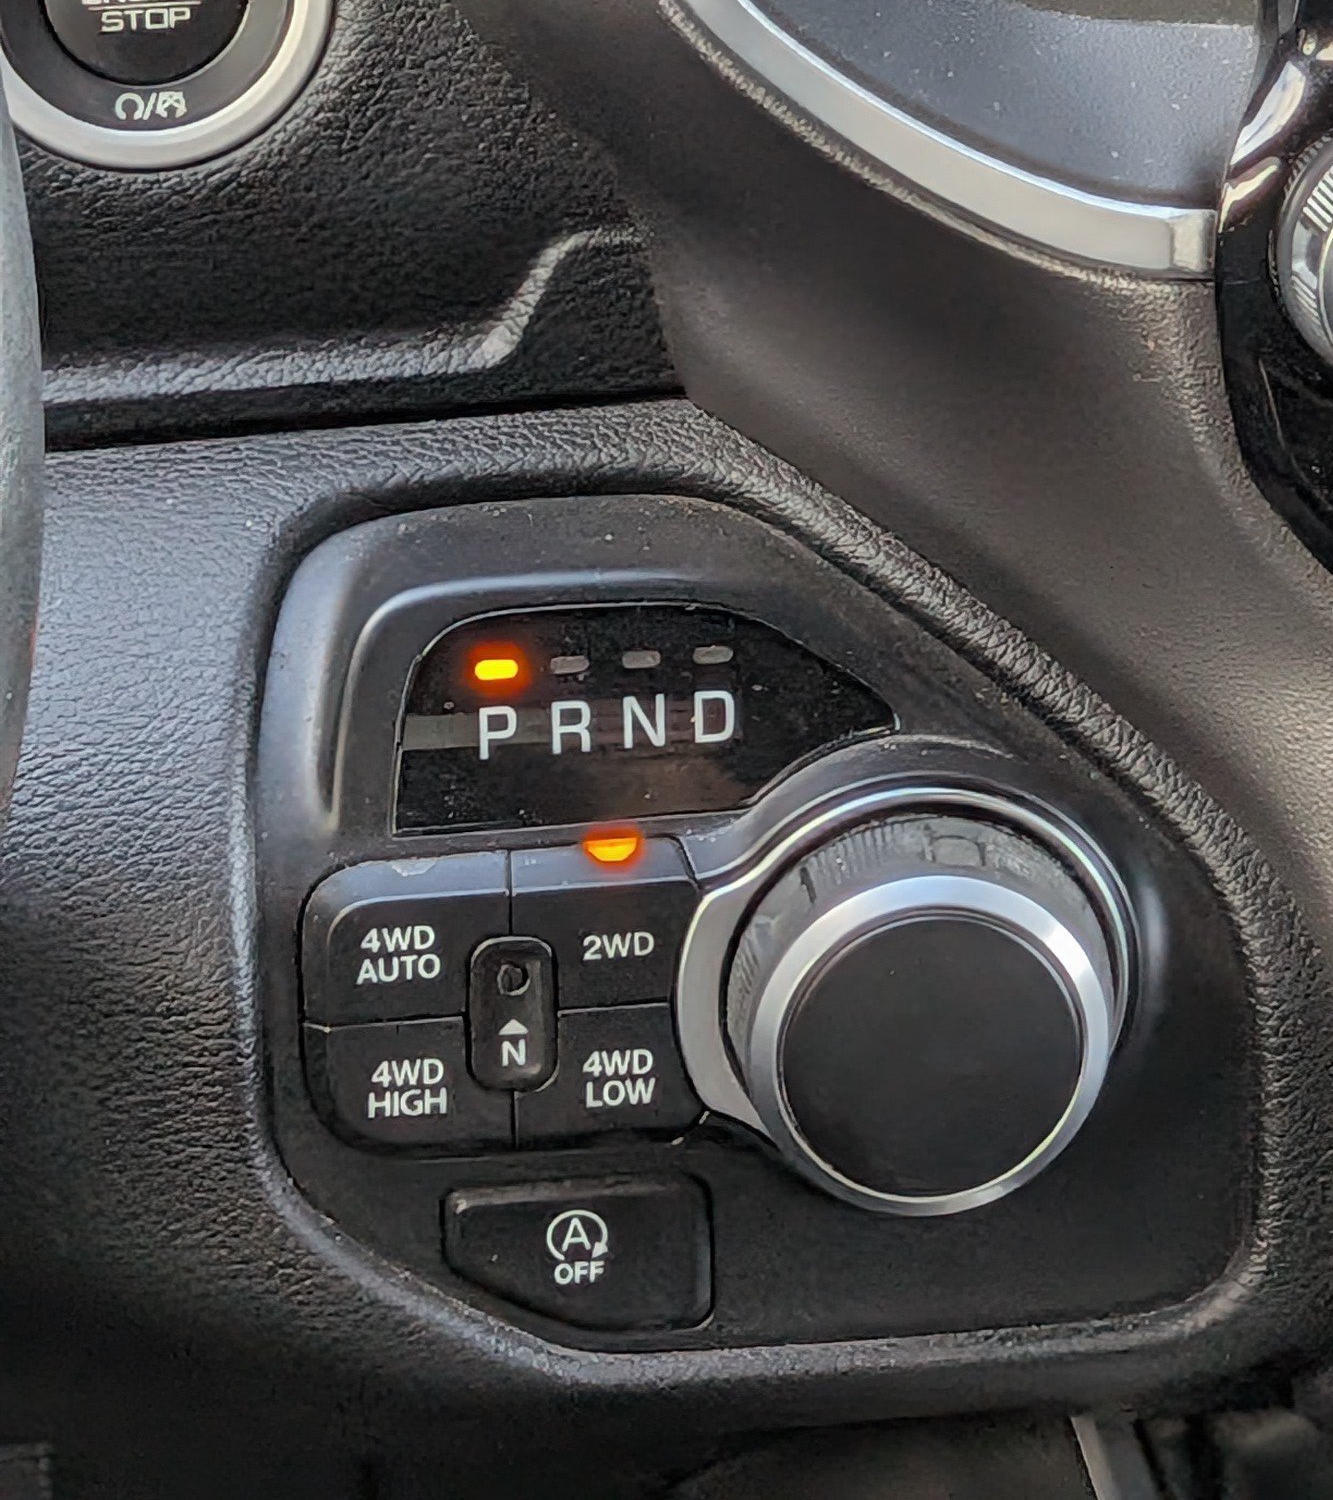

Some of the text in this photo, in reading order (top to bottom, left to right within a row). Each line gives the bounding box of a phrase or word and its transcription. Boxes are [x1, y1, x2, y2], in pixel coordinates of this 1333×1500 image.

[100, 7, 191, 33] STOP
[479, 690, 736, 761] P R N D
[360, 924, 436, 953] 4WD
[582, 930, 655, 961] 2WD
[356, 952, 441, 986] AUTO
[502, 1039, 526, 1067] N
[582, 1048, 654, 1077] 4WD
[371, 1058, 445, 1088] 4WD
[367, 1087, 447, 1119] HIGH
[585, 1077, 656, 1109] LOW
[553, 1262, 605, 1286] OFF
